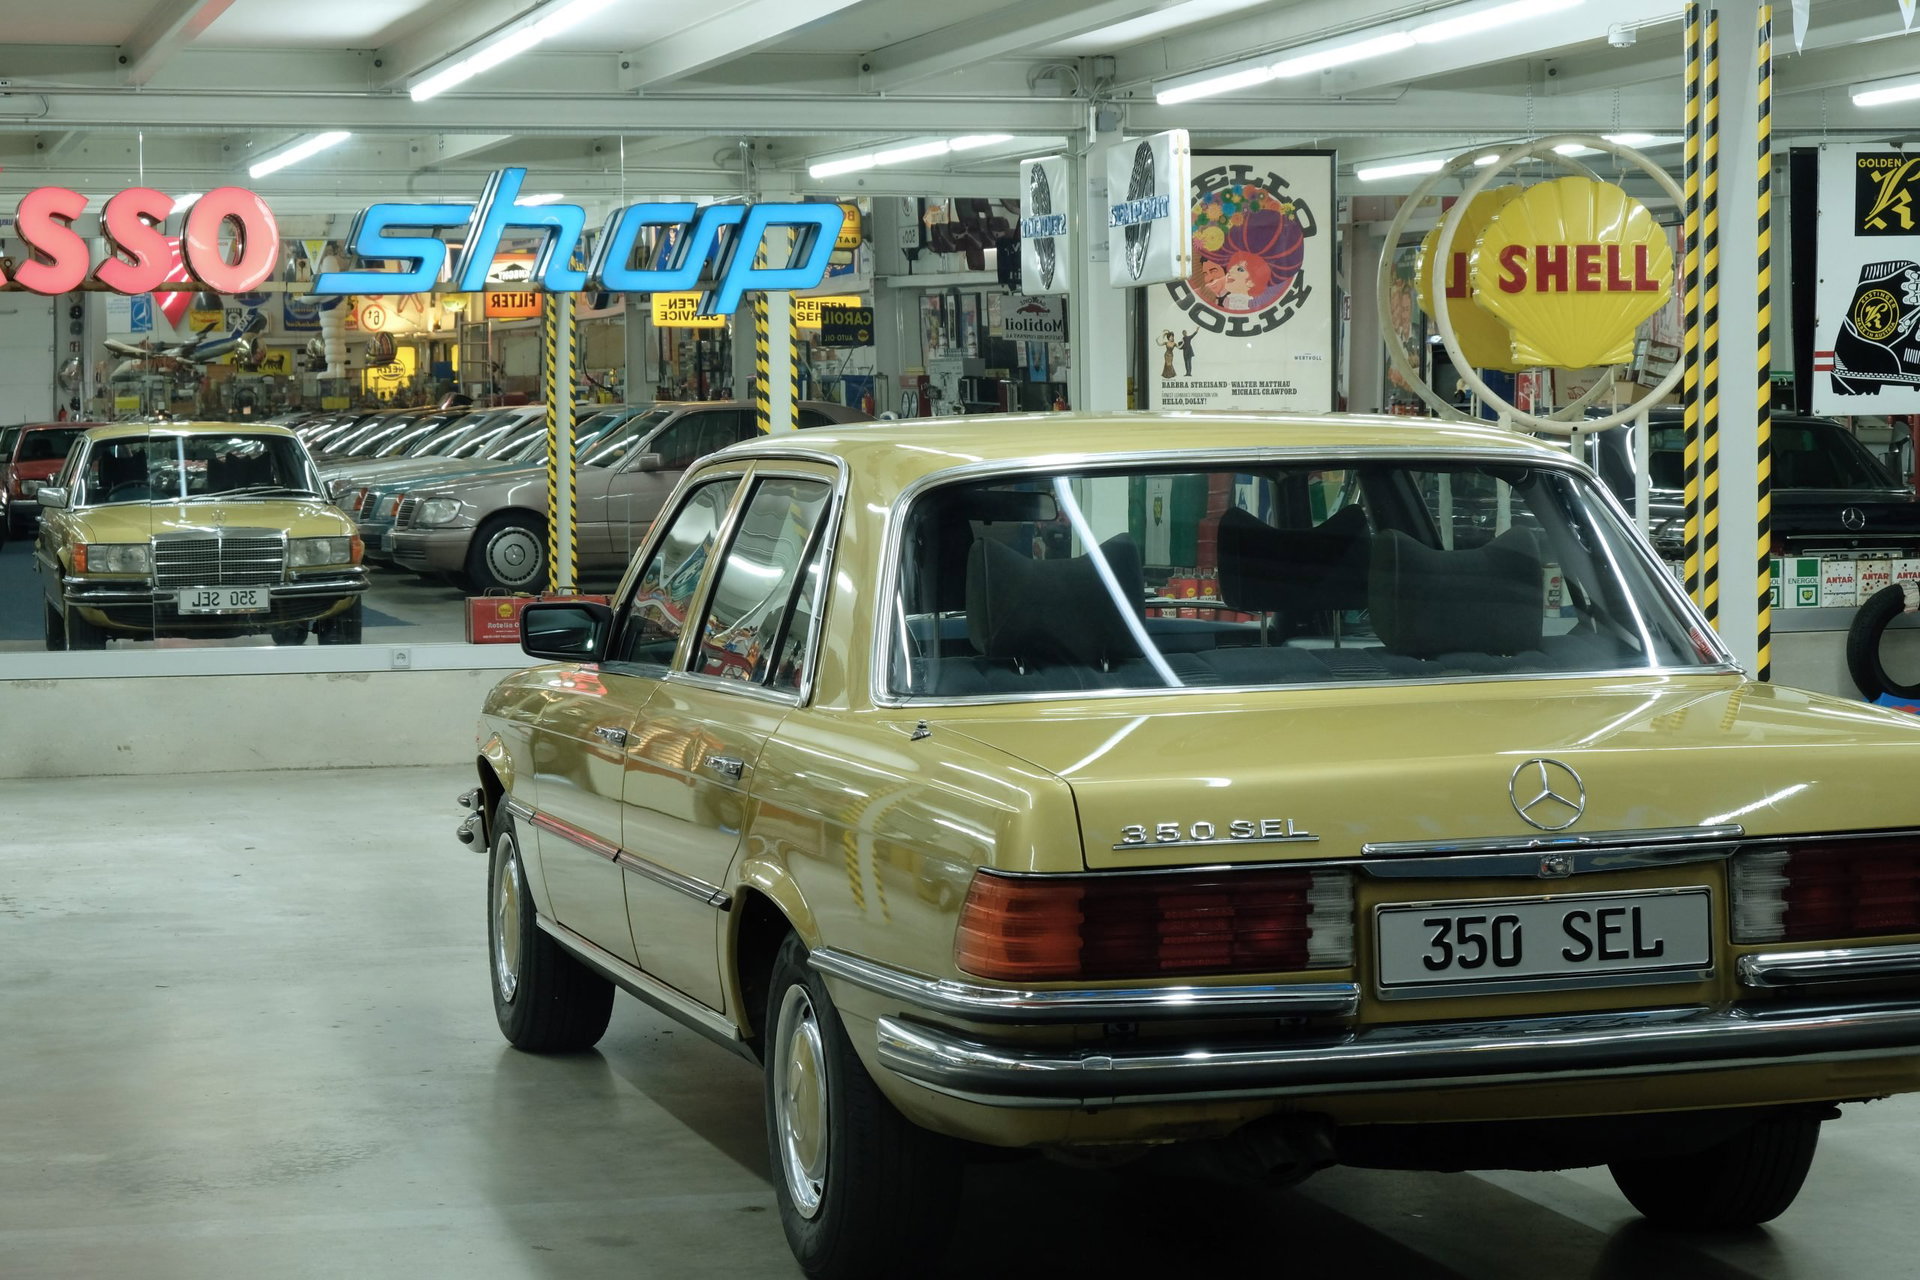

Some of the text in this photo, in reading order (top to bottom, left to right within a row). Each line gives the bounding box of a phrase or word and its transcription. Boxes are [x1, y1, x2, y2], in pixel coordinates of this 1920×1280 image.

[1858, 158, 1902, 168] GOLDEN
[0, 167, 845, 316] SSO shop
[1498, 244, 1659, 295] SHELL
[1166, 269, 1312, 337] DOLLY
[1161, 380, 1291, 389] BARBRA STREISAND WALTER MATTHAU
[1232, 388, 1298, 396] MICHAEL CRAWFORD
[1162, 397, 1207, 406] HELLO, DOLLY!
[1787, 576, 1818, 585] ENERGOL
[1826, 576, 1853, 584] ANTAR
[1862, 572, 1890, 580] ANTAR
[1121, 818, 1310, 844] 350 SEL
[1421, 907, 1664, 972] 350 SEL
